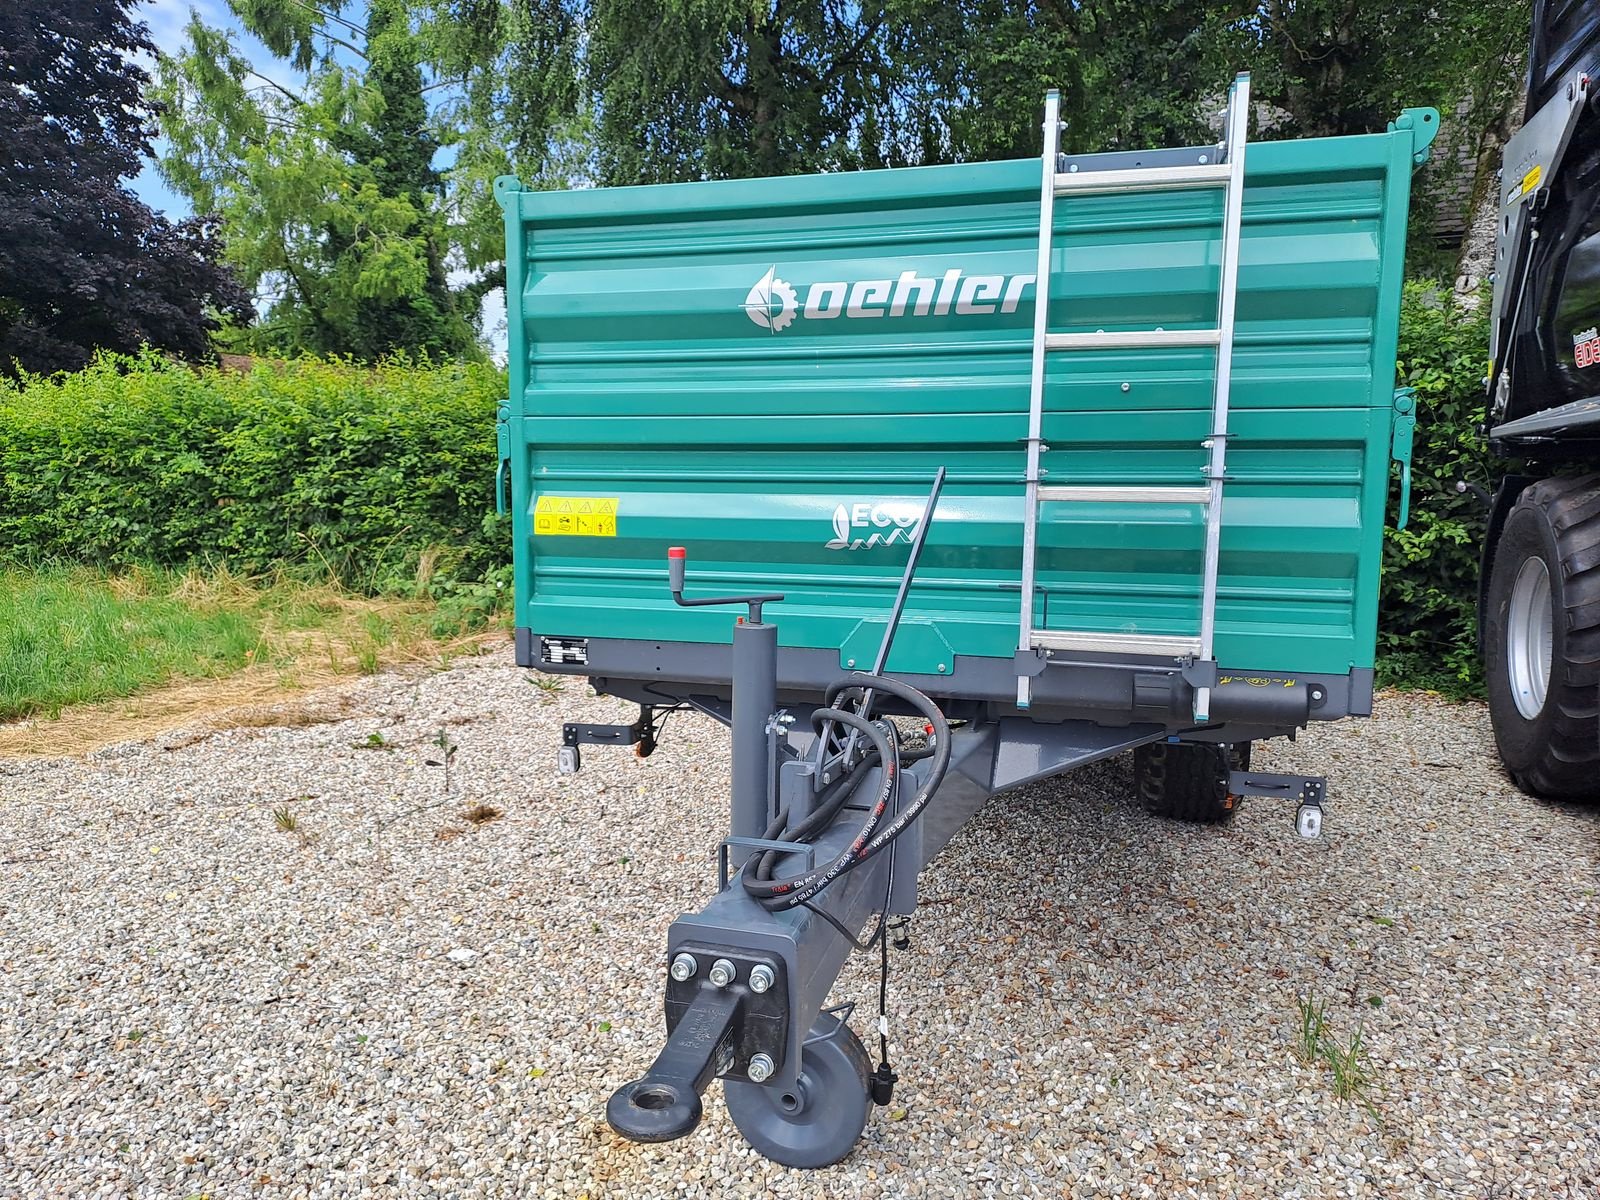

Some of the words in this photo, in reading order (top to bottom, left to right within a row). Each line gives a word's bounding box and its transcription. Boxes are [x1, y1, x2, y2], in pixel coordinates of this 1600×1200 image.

[803, 268, 1037, 320] oehler
[851, 503, 915, 528] ECO
[871, 836, 883, 848] WP
[883, 826, 897, 840] 275
[895, 818, 906, 830] bar
[906, 801, 921, 817] 3990
[919, 793, 928, 804] psi
[827, 865, 841, 879] 330
